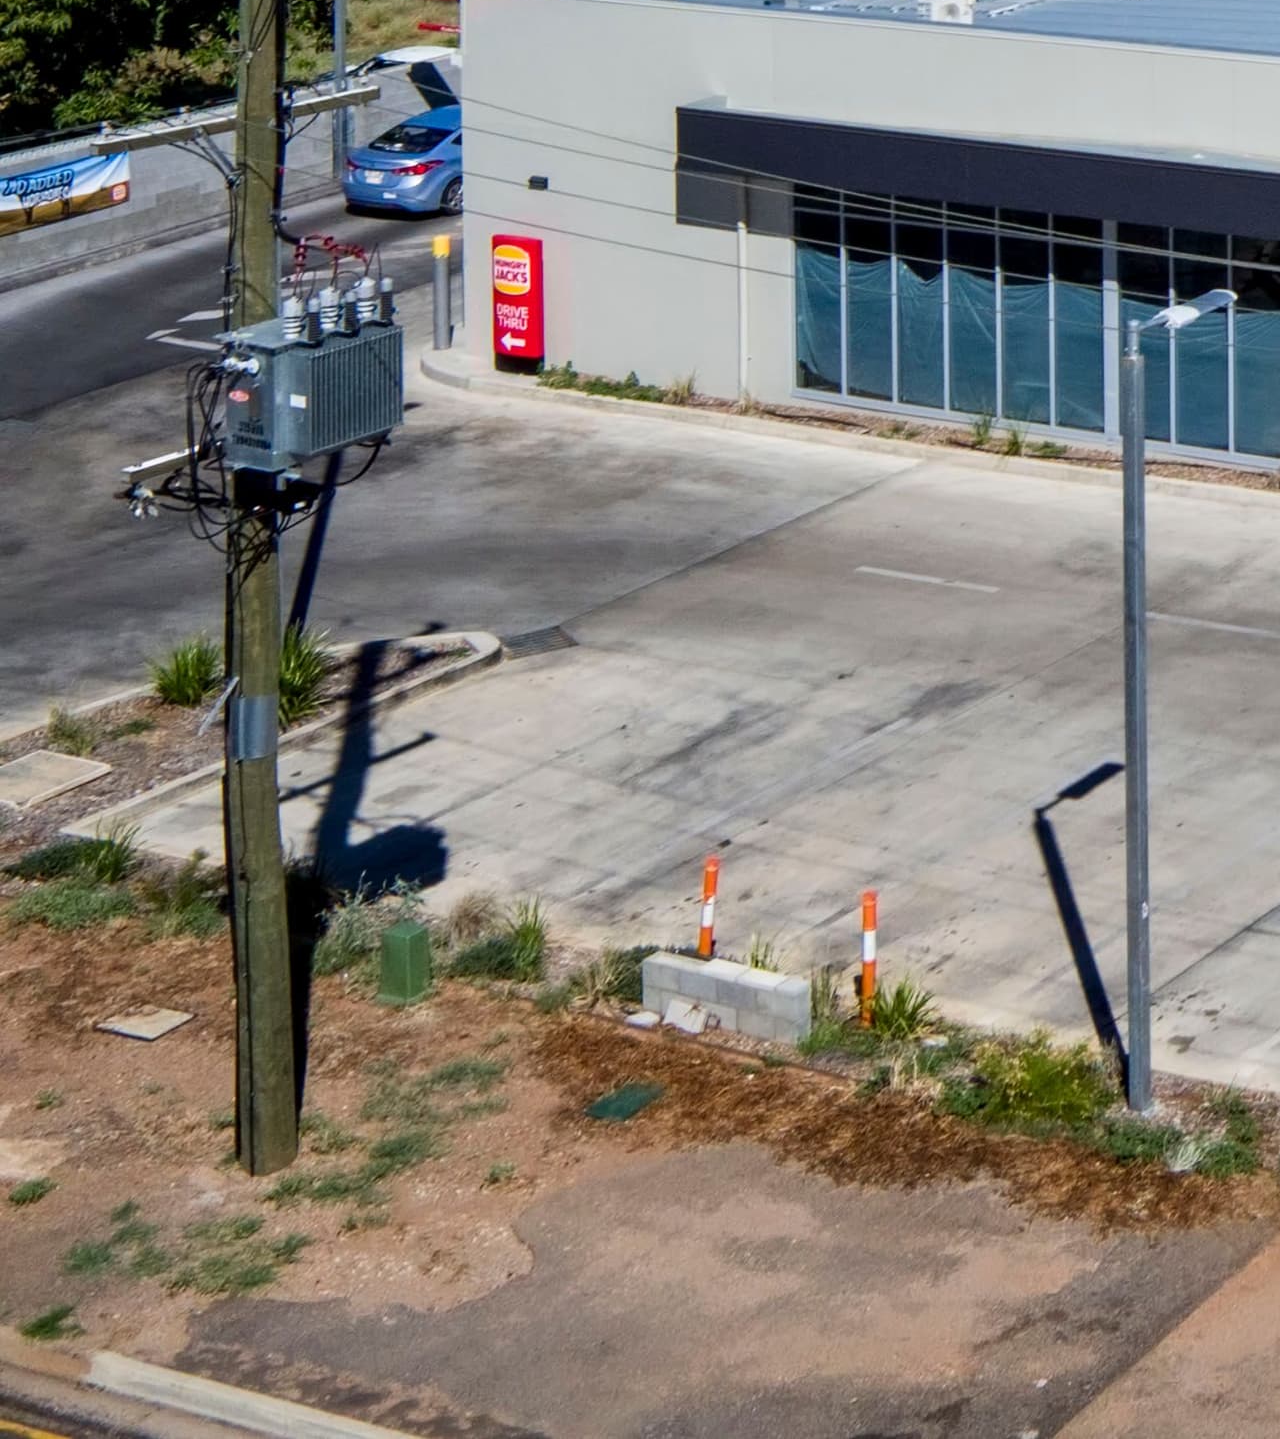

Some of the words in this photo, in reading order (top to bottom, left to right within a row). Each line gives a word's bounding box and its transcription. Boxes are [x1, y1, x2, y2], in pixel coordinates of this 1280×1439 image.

[27, 169, 73, 193] ADDED
[496, 303, 529, 319] DRIVE
[498, 316, 528, 331] THRU
